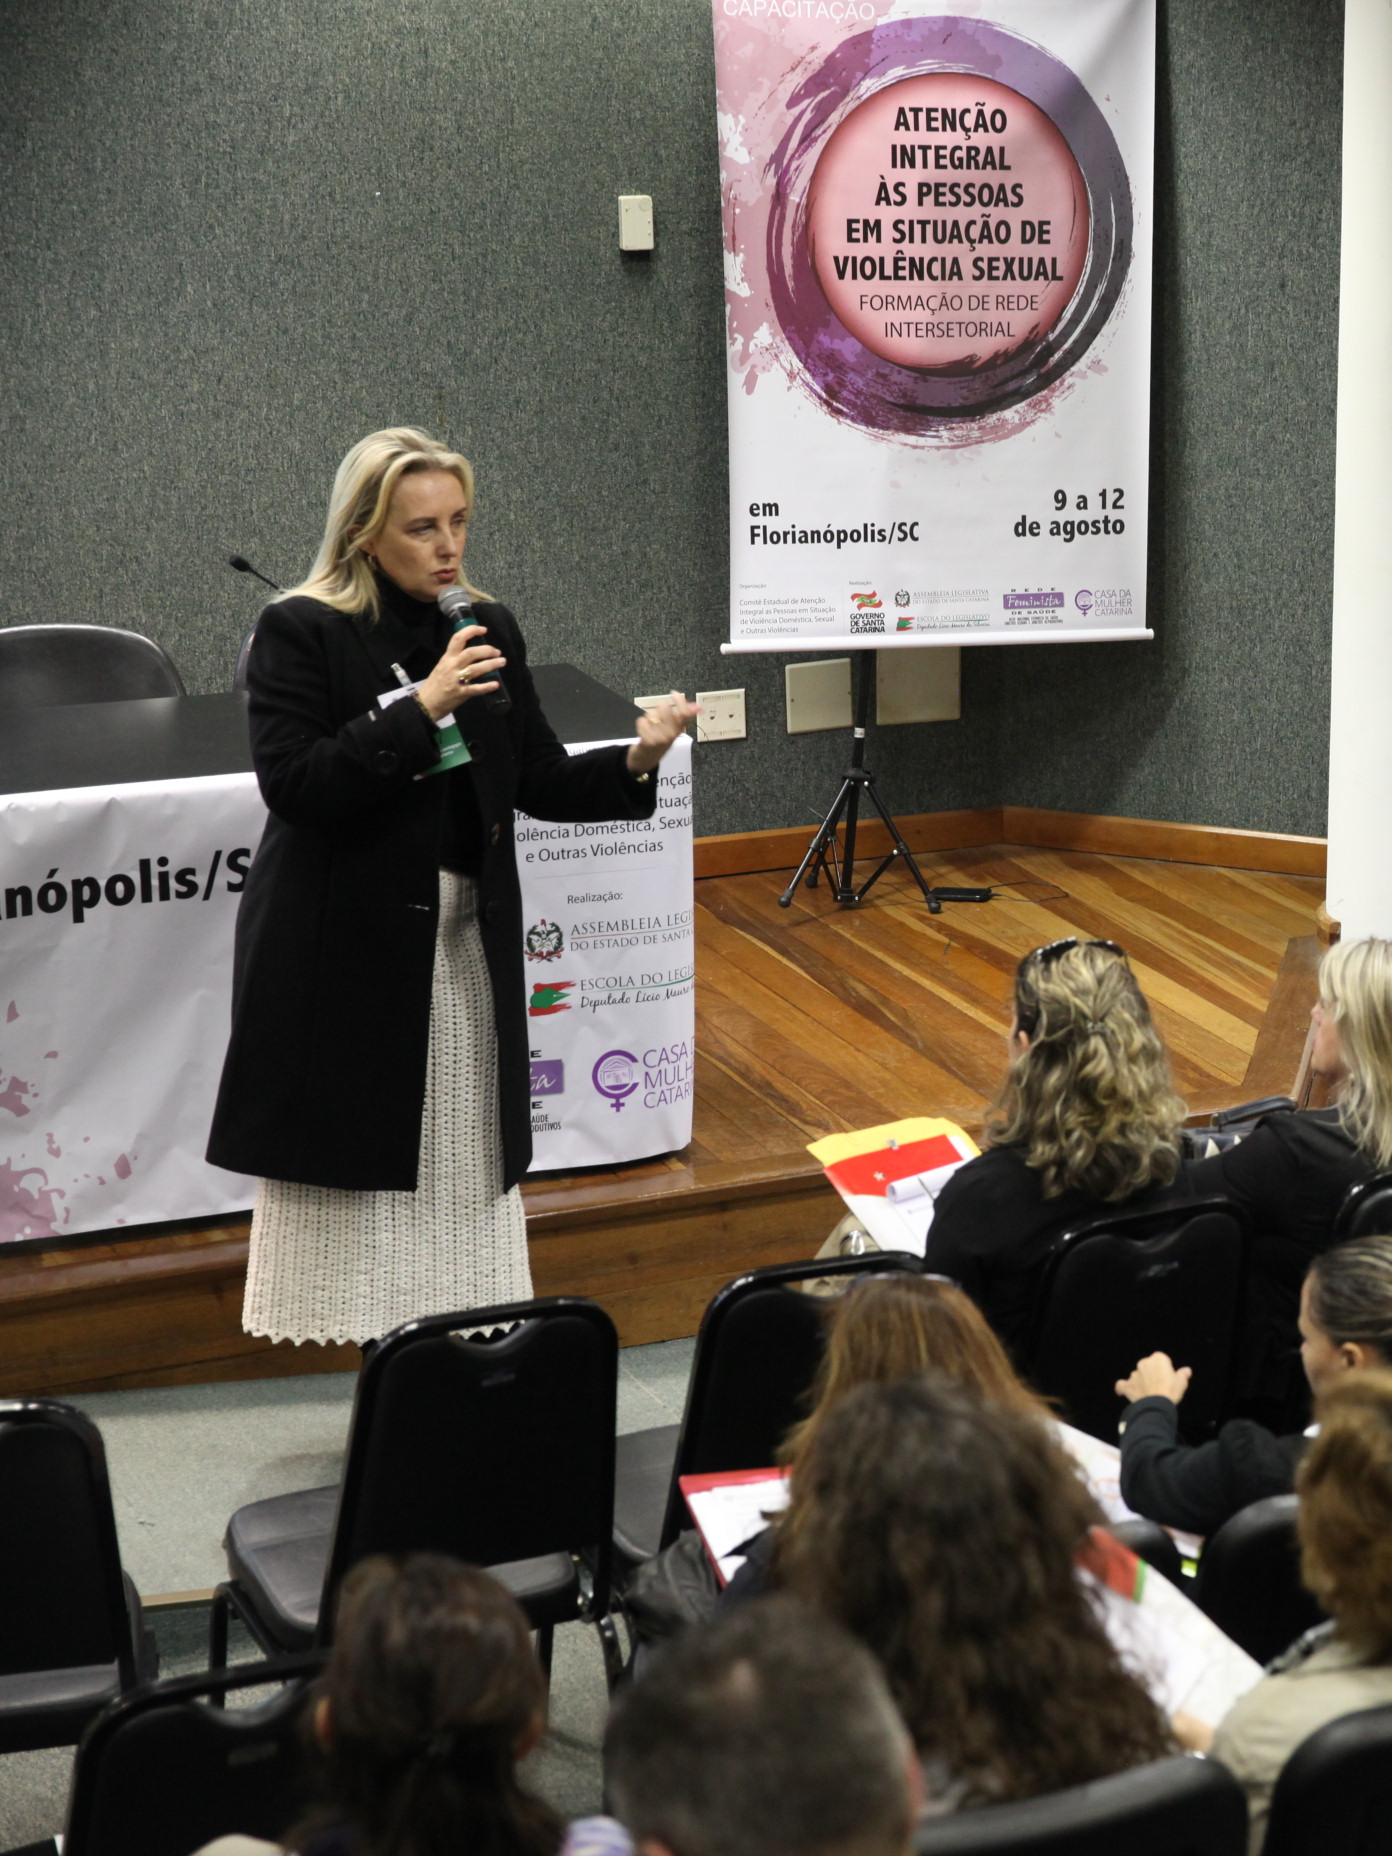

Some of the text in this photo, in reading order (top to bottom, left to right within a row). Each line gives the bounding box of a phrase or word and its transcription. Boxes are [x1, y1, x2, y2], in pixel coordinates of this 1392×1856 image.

[723, 0, 875, 23] CAPACITAÇÃO
[894, 103, 1007, 139] ATENÇÃO
[891, 144, 1011, 171] INTEGRAL
[875, 175, 1024, 208] ÀS PESSOAS
[846, 214, 1051, 251] EM SITUAÇÃO DE
[833, 250, 1064, 282] VIOLÊNCIA SEXUAL
[859, 292, 1039, 316] FORMAÇÃO DE REDE
[884, 321, 1015, 338] INTERSETORIAL
[749, 502, 780, 517] em
[1053, 488, 1125, 510] 9 a 12
[749, 521, 920, 550] Florianópolis/SC
[1013, 515, 1126, 543] de agosto
[764, 598, 790, 606] Estadual
[800, 597, 826, 606] Atenção
[1006, 594, 1061, 608] Feminista
[1094, 589, 1132, 598] CASA DA
[1094, 598, 1132, 608] MULHER
[740, 608, 764, 616] Integral
[810, 606, 836, 614] Situação
[1094, 607, 1133, 616] CATARINA
[517, 816, 692, 842] olência Doméstica, Sexu
[526, 840, 664, 863] e Outras Violências
[0, 848, 252, 923] nópolis/S
[567, 892, 623, 905] Realização:
[571, 916, 662, 936] ASSEMBLEIA
[570, 940, 589, 952] DO
[593, 936, 639, 949] ESTADO
[643, 935, 659, 945] DE
[662, 928, 691, 943] SANTA
[580, 975, 635, 991] ESCOLA
[641, 972, 663, 986] DO
[581, 991, 631, 1013] Deputado
[635, 990, 661, 1003] Lício
[643, 1041, 688, 1068] CASA
[645, 1061, 693, 1089] MULH
[644, 1081, 690, 1108] CATAR
[531, 1113, 549, 1123] AÚDE
[531, 1122, 561, 1132] ODUTIVOS
